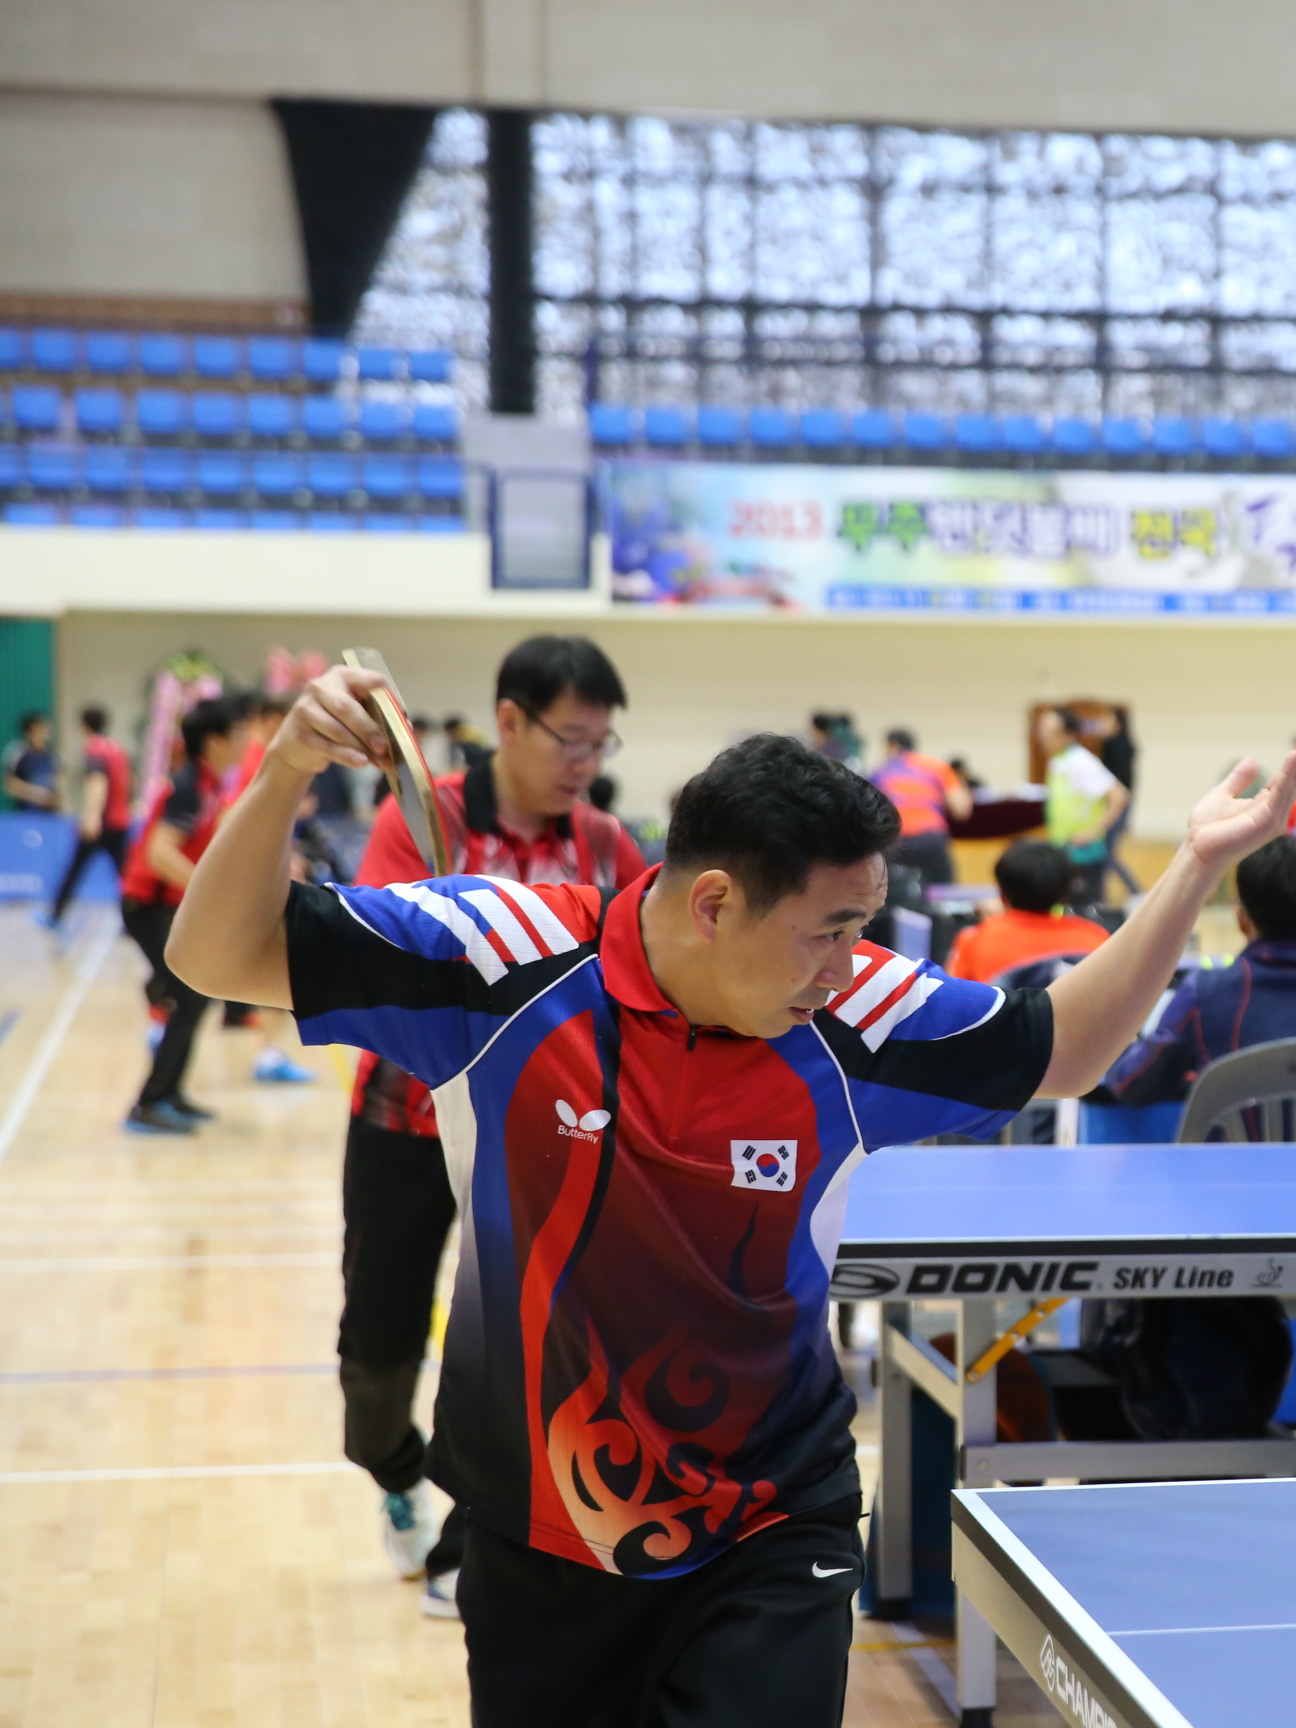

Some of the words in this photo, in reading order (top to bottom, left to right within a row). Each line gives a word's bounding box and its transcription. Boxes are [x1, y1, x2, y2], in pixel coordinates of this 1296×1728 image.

[730, 499, 822, 541] 2013
[557, 1125, 599, 1144] Butterfly
[906, 1261, 1099, 1294] DONIC
[1113, 1266, 1167, 1290] SKY
[1174, 1266, 1235, 1289] Line
[1056, 1656, 1118, 1728] CHAMP
